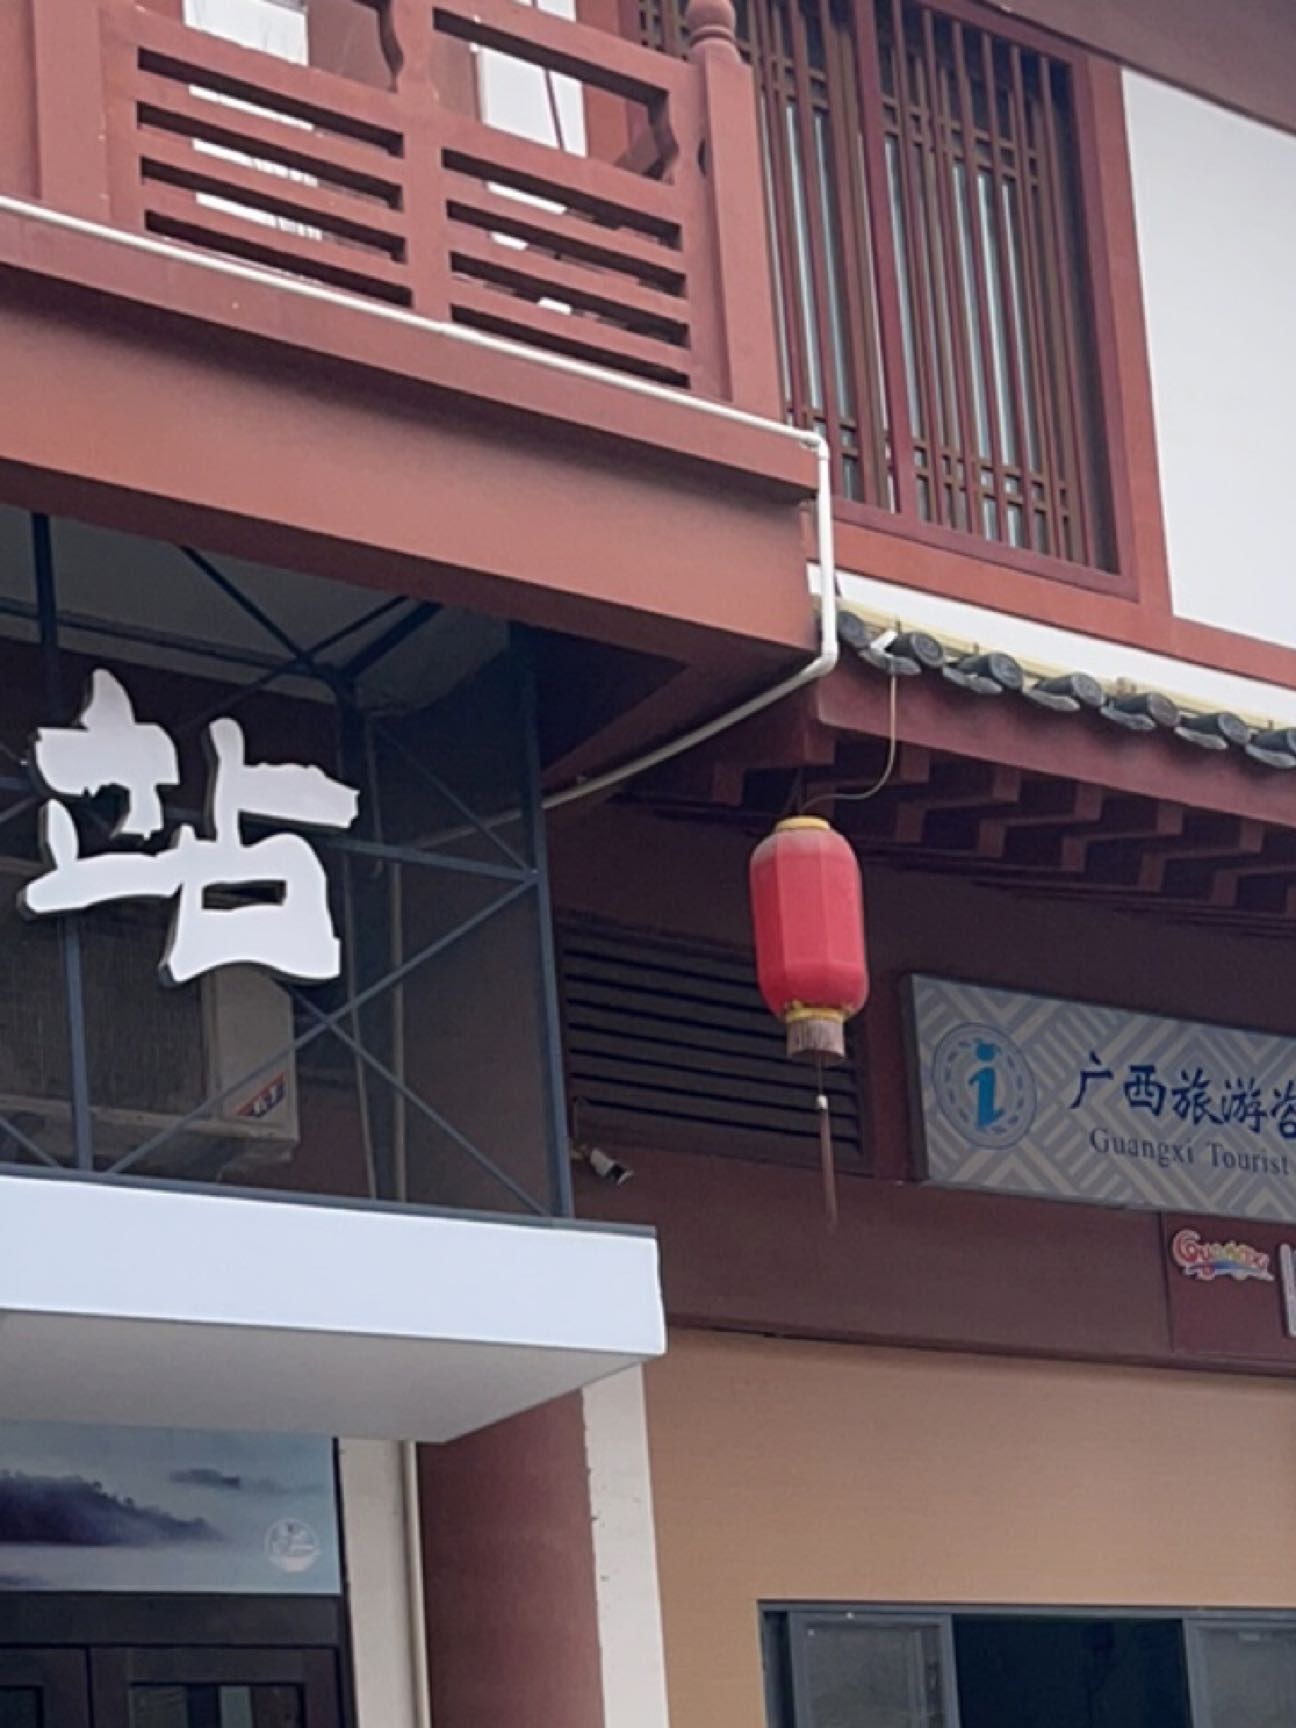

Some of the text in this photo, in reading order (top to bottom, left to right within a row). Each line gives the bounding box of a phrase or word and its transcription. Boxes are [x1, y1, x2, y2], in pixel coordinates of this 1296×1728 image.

[22, 668, 361, 984] 站
[1089, 1127, 1194, 1168] Guangxi
[1207, 1141, 1289, 1176] Tourist
